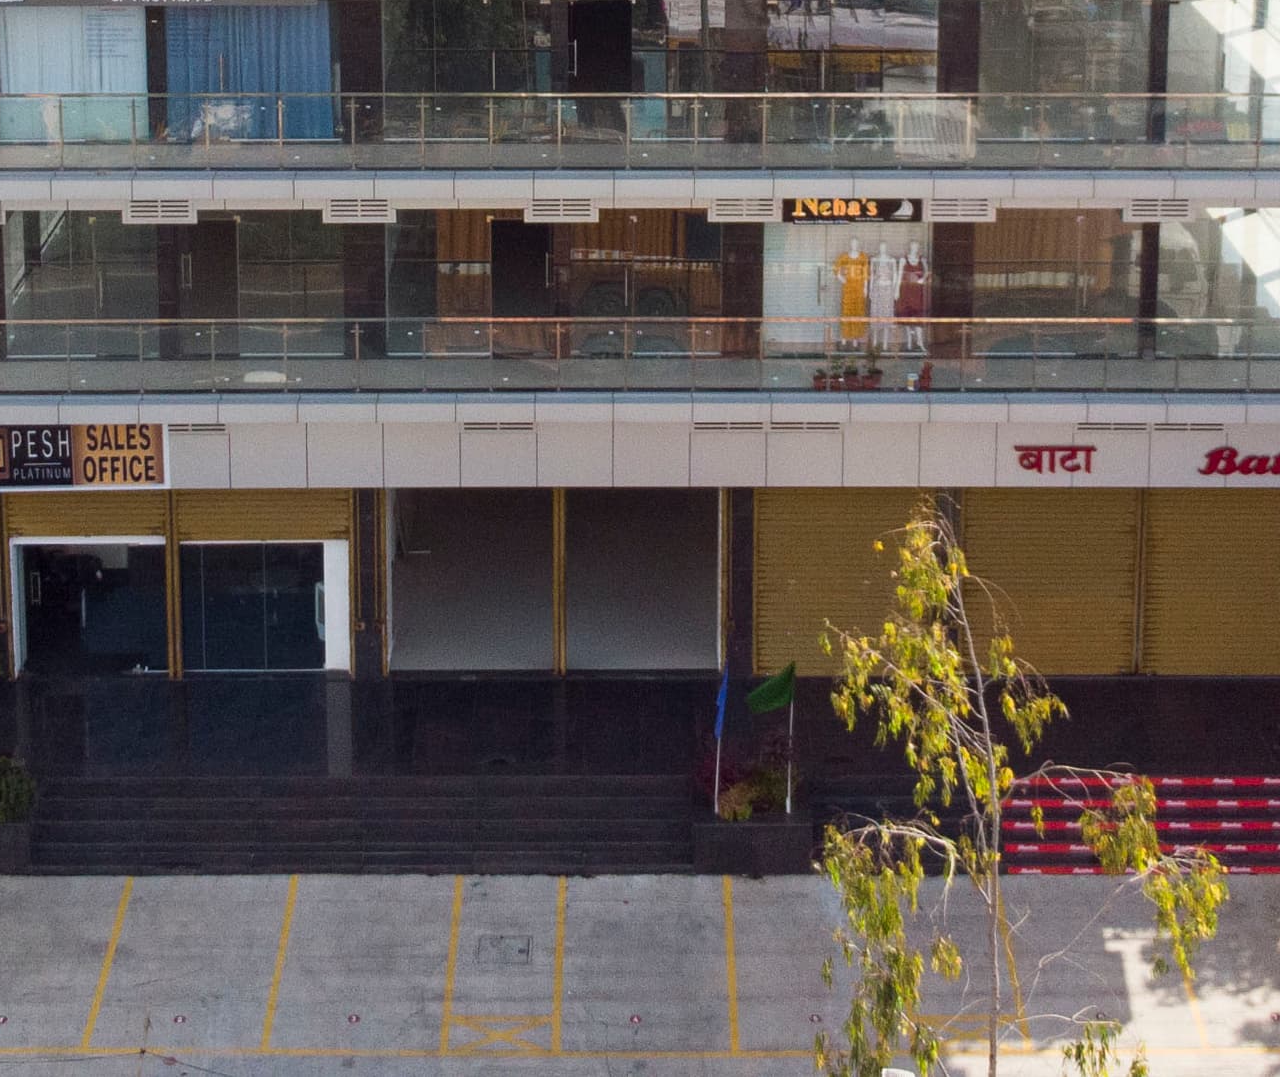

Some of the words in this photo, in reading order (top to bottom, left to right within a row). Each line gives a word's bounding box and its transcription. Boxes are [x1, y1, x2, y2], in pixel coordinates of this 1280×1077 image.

[792, 198, 878, 217] Neha's
[12, 430, 70, 458] PESH
[87, 424, 152, 451] SALES
[83, 455, 156, 483] OFFICE
[1014, 445, 1098, 474] बाटा
[13, 467, 72, 481] PLATINUM
